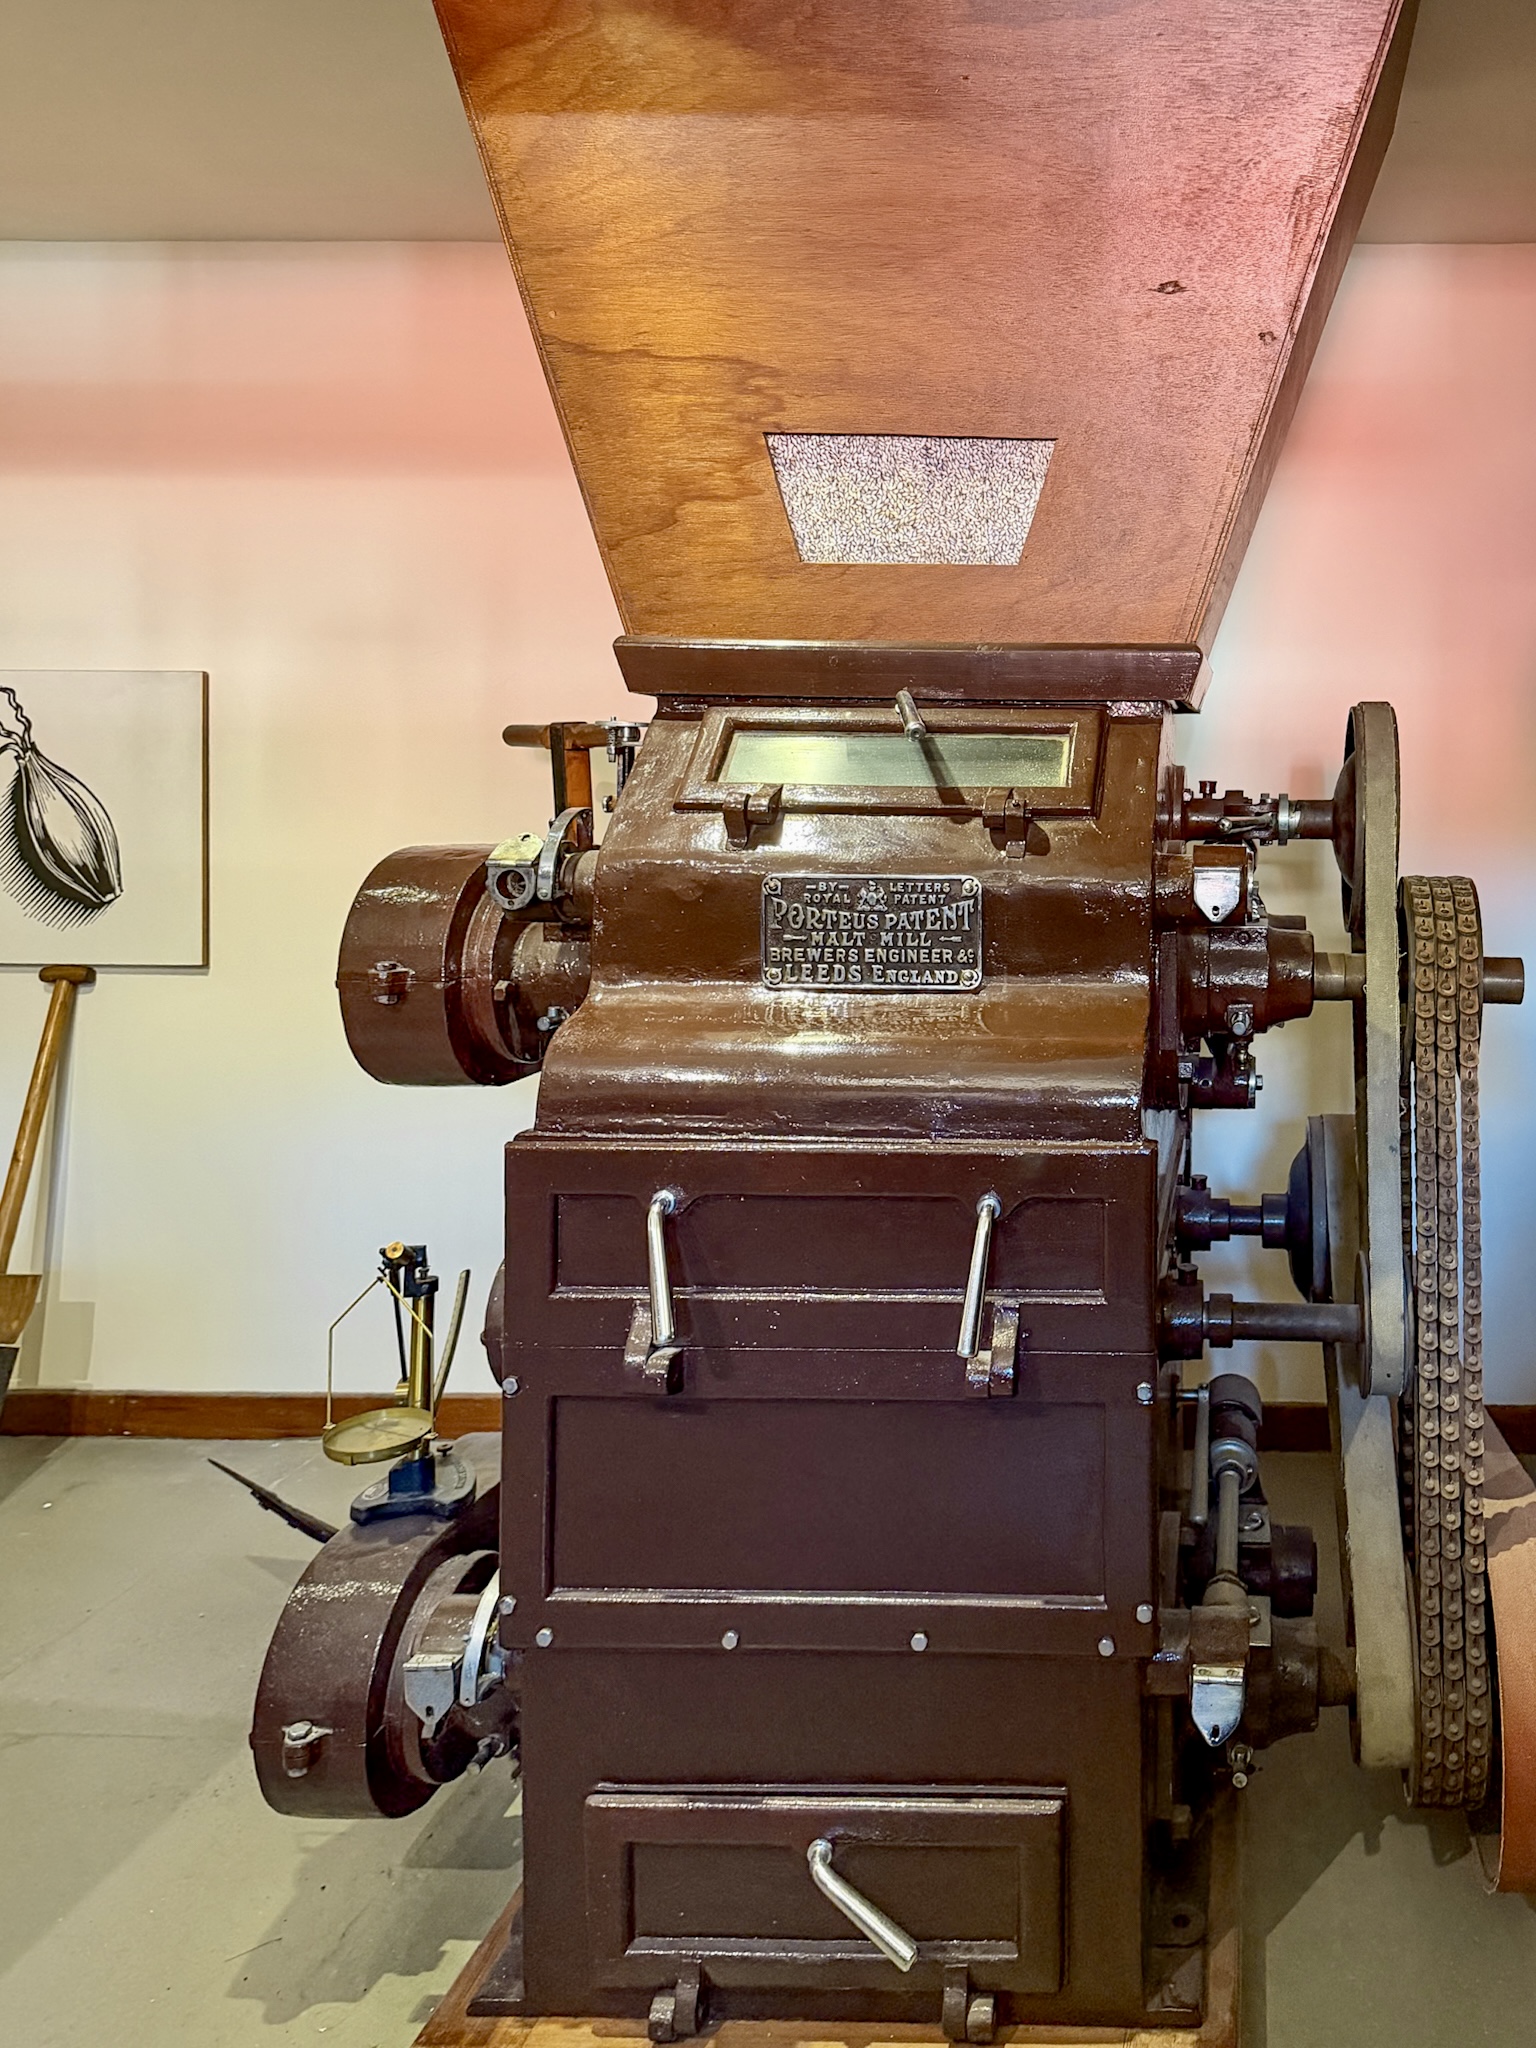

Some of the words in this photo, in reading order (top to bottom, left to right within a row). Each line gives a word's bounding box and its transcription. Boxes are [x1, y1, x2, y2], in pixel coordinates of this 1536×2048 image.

[819, 882, 837, 892] BY
[890, 882, 951, 893] LETTERS
[803, 893, 851, 904] ROYAL
[894, 894, 946, 905] PATENT
[770, 897, 879, 930] PORTEUS
[885, 899, 975, 931] PATENT
[811, 932, 866, 946] MALT
[880, 932, 932, 947] MILL
[770, 948, 858, 962] BREWERS
[864, 948, 952, 963] ENGINEER
[785, 964, 862, 983] LEEDS
[872, 965, 958, 983] ENGLAND
